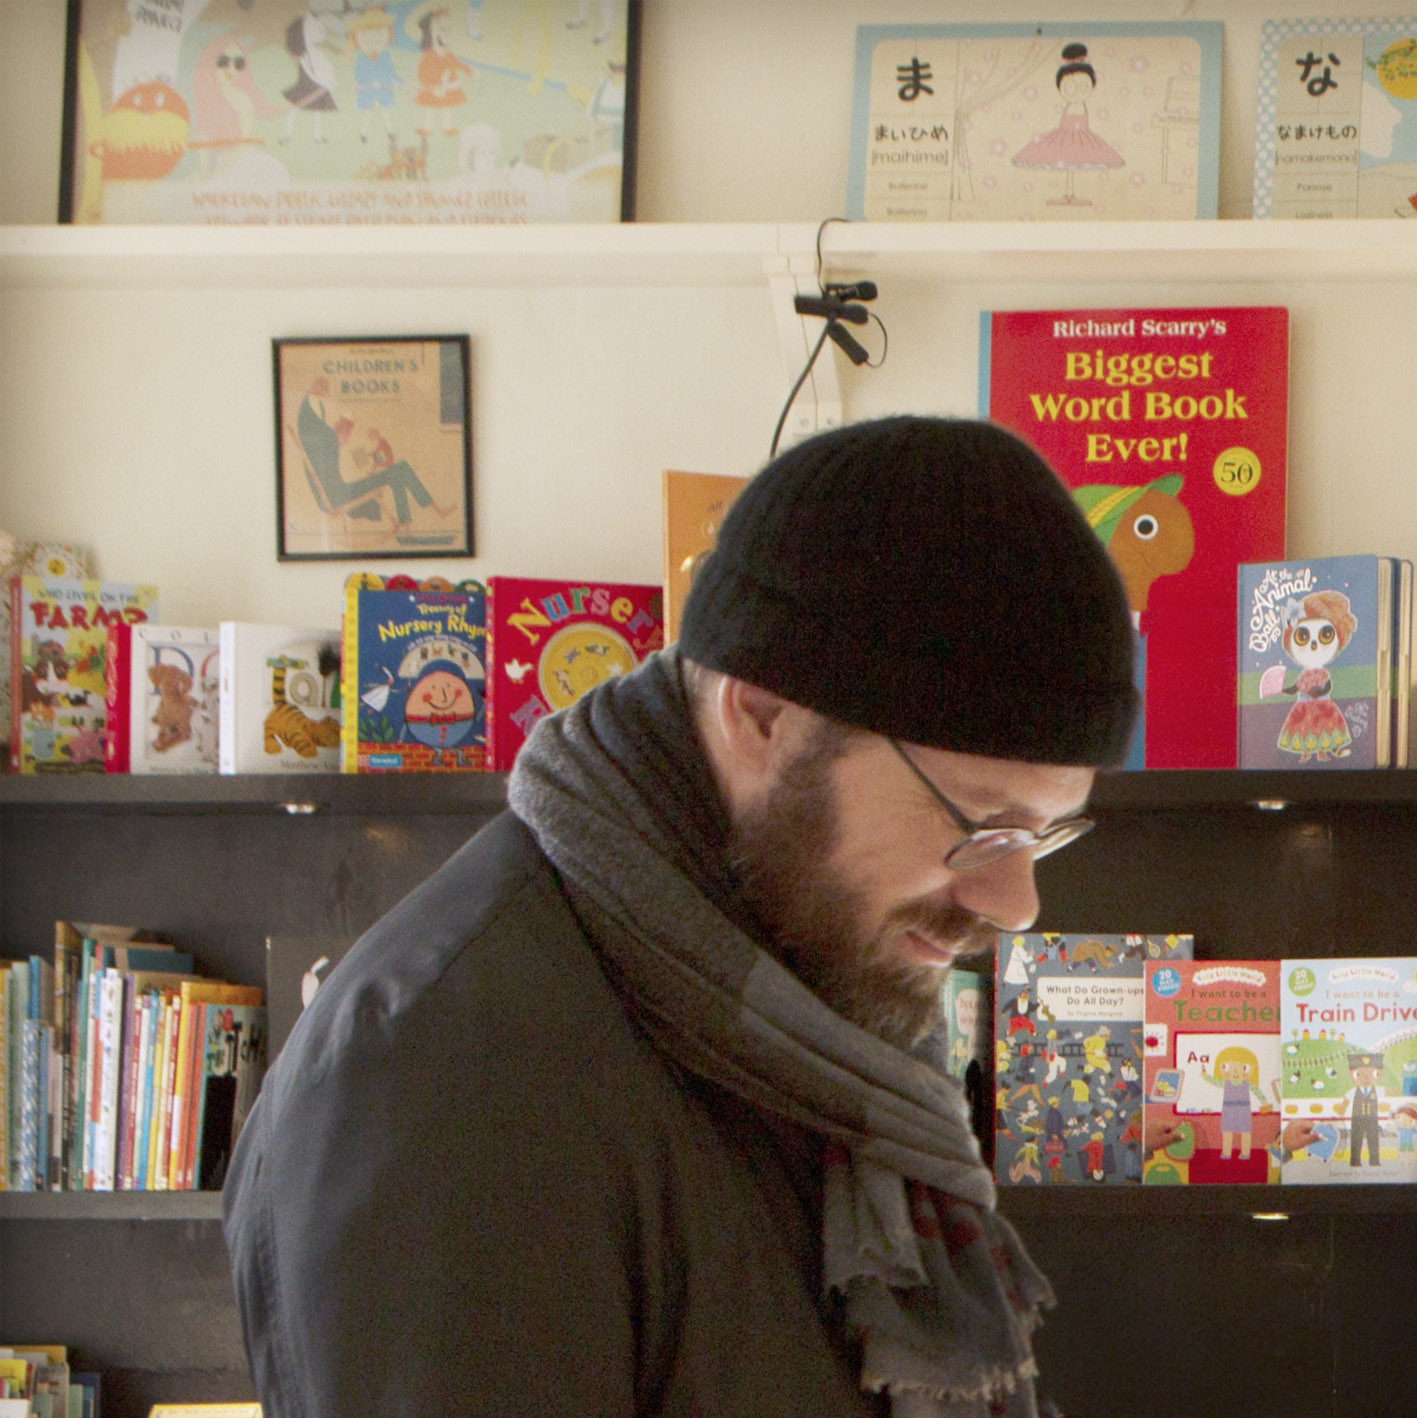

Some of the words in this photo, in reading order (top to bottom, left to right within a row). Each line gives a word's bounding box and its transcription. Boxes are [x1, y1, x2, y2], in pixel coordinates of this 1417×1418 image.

[896, 56, 934, 101] ま
[1295, 51, 1341, 96] な
[874, 124, 949, 141] まいひめ
[1277, 124, 1357, 141] なまけもの
[1053, 319, 1135, 338] Richard
[1141, 319, 1227, 340] Scarry's
[323, 358, 418, 375] CHILDREN'S
[1065, 349, 1214, 387] Biggest
[341, 379, 400, 394] BOOKS
[1029, 389, 1131, 422] Word
[1145, 388, 1249, 421] Book
[1085, 433, 1189, 463] Ever!
[378, 615, 442, 643] Nursery
[447, 615, 486, 639] Rhym
[1047, 985, 1071, 994] What
[1075, 986, 1088, 994] Do
[1296, 1003, 1355, 1022] Train
